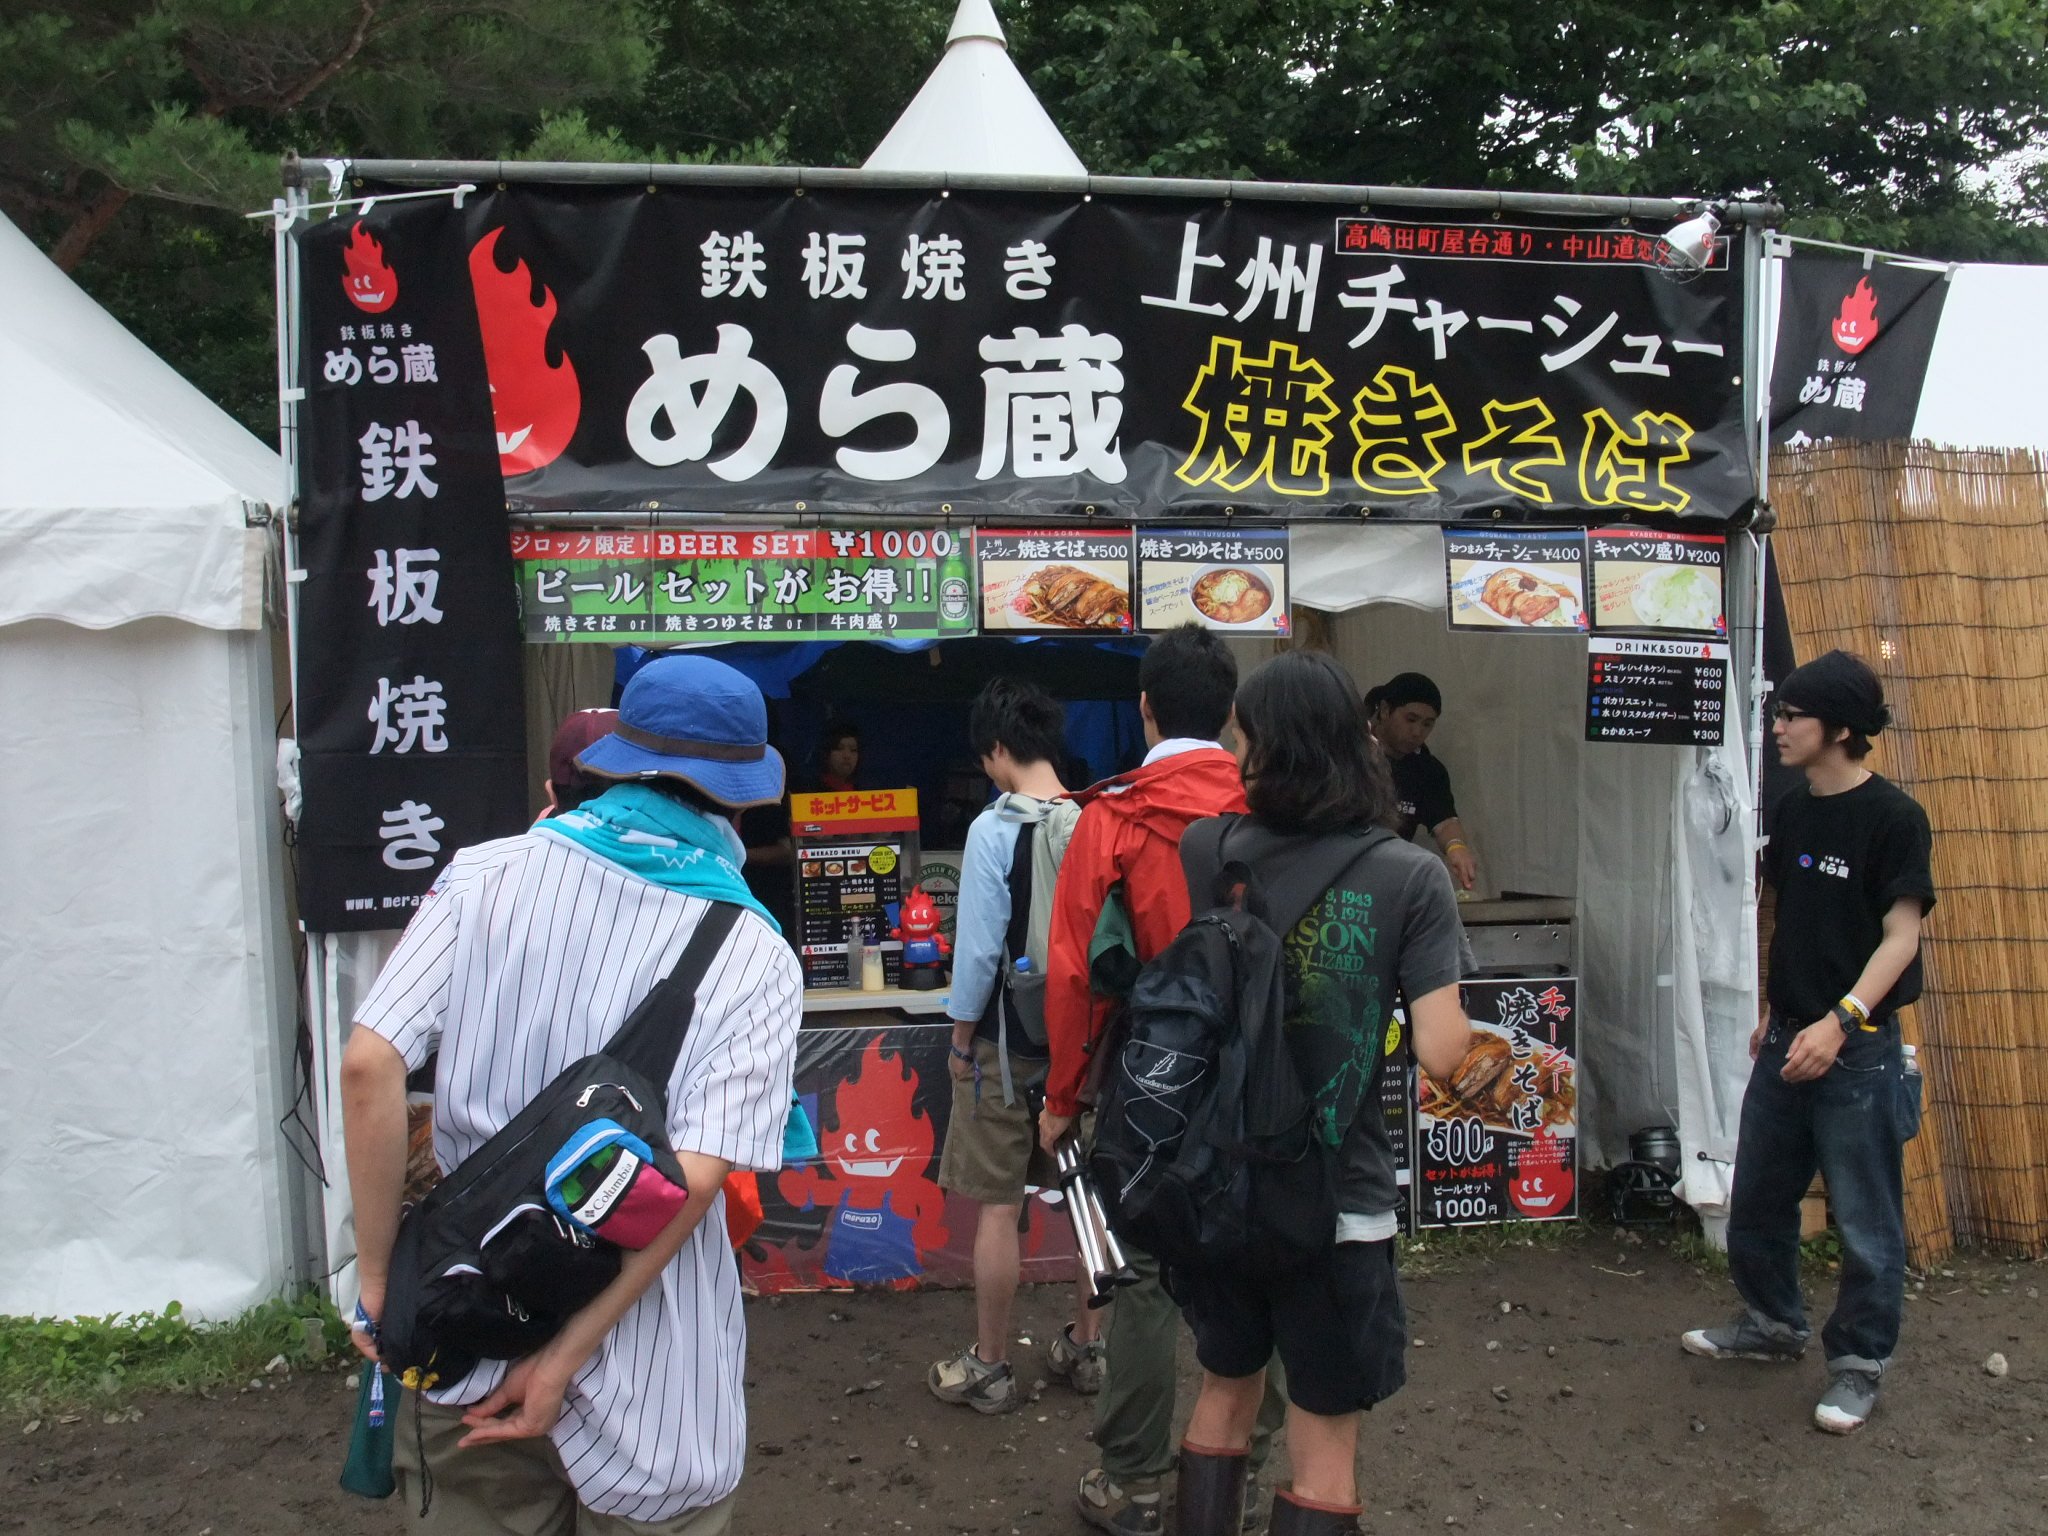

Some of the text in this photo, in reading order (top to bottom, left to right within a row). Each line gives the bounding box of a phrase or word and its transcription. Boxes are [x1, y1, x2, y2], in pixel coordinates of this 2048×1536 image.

[699, 231, 1056, 301] 鉄板焼き
[1140, 221, 1724, 378] 上州チャーシュー
[340, 323, 413, 341] 鉄板焼き
[323, 343, 439, 386] めら蔵
[625, 322, 1128, 485] めら蔵
[1174, 336, 1694, 513] 焼きそば
[658, 534, 739, 555] BEER
[752, 534, 810, 555] SET
[829, 530, 952, 558] ¥1000
[1017, 539, 1086, 559] 焼きそば
[1088, 544, 1128, 558] ¥500
[1139, 538, 1283, 561] 焼きつゆそば ¥500
[1541, 547, 1581, 561] ¥400
[1594, 539, 1721, 564] キャベツ盛り ¥200
[544, 613, 899, 632] 焼きそば or 焼きつゆそば or 牛肉盛り
[357, 419, 450, 871] 鉄板焼き
[1615, 642, 1699, 655] DRINK&SOUP
[1604, 675, 1722, 690] スミノフアイス ¥600
[1695, 667, 1722, 678] ¥600
[1602, 696, 1721, 711] ポカリスエット ¥200
[1693, 711, 1720, 722] ¥200
[1601, 727, 1720, 740] わかめスープ ¥300
[809, 793, 897, 816] ホットサービス
[345, 895, 425, 911] www.mera
[1341, 890, 1373, 907] 1943
[1341, 907, 1369, 925] 1971
[1537, 986, 1574, 1094] チャーシュー
[1497, 987, 1543, 1131] 焼きそば
[593, 1163, 632, 1211] Columbia
[1433, 1181, 1492, 1196] ビールセット
[1435, 1197, 1498, 1219] 1000円
